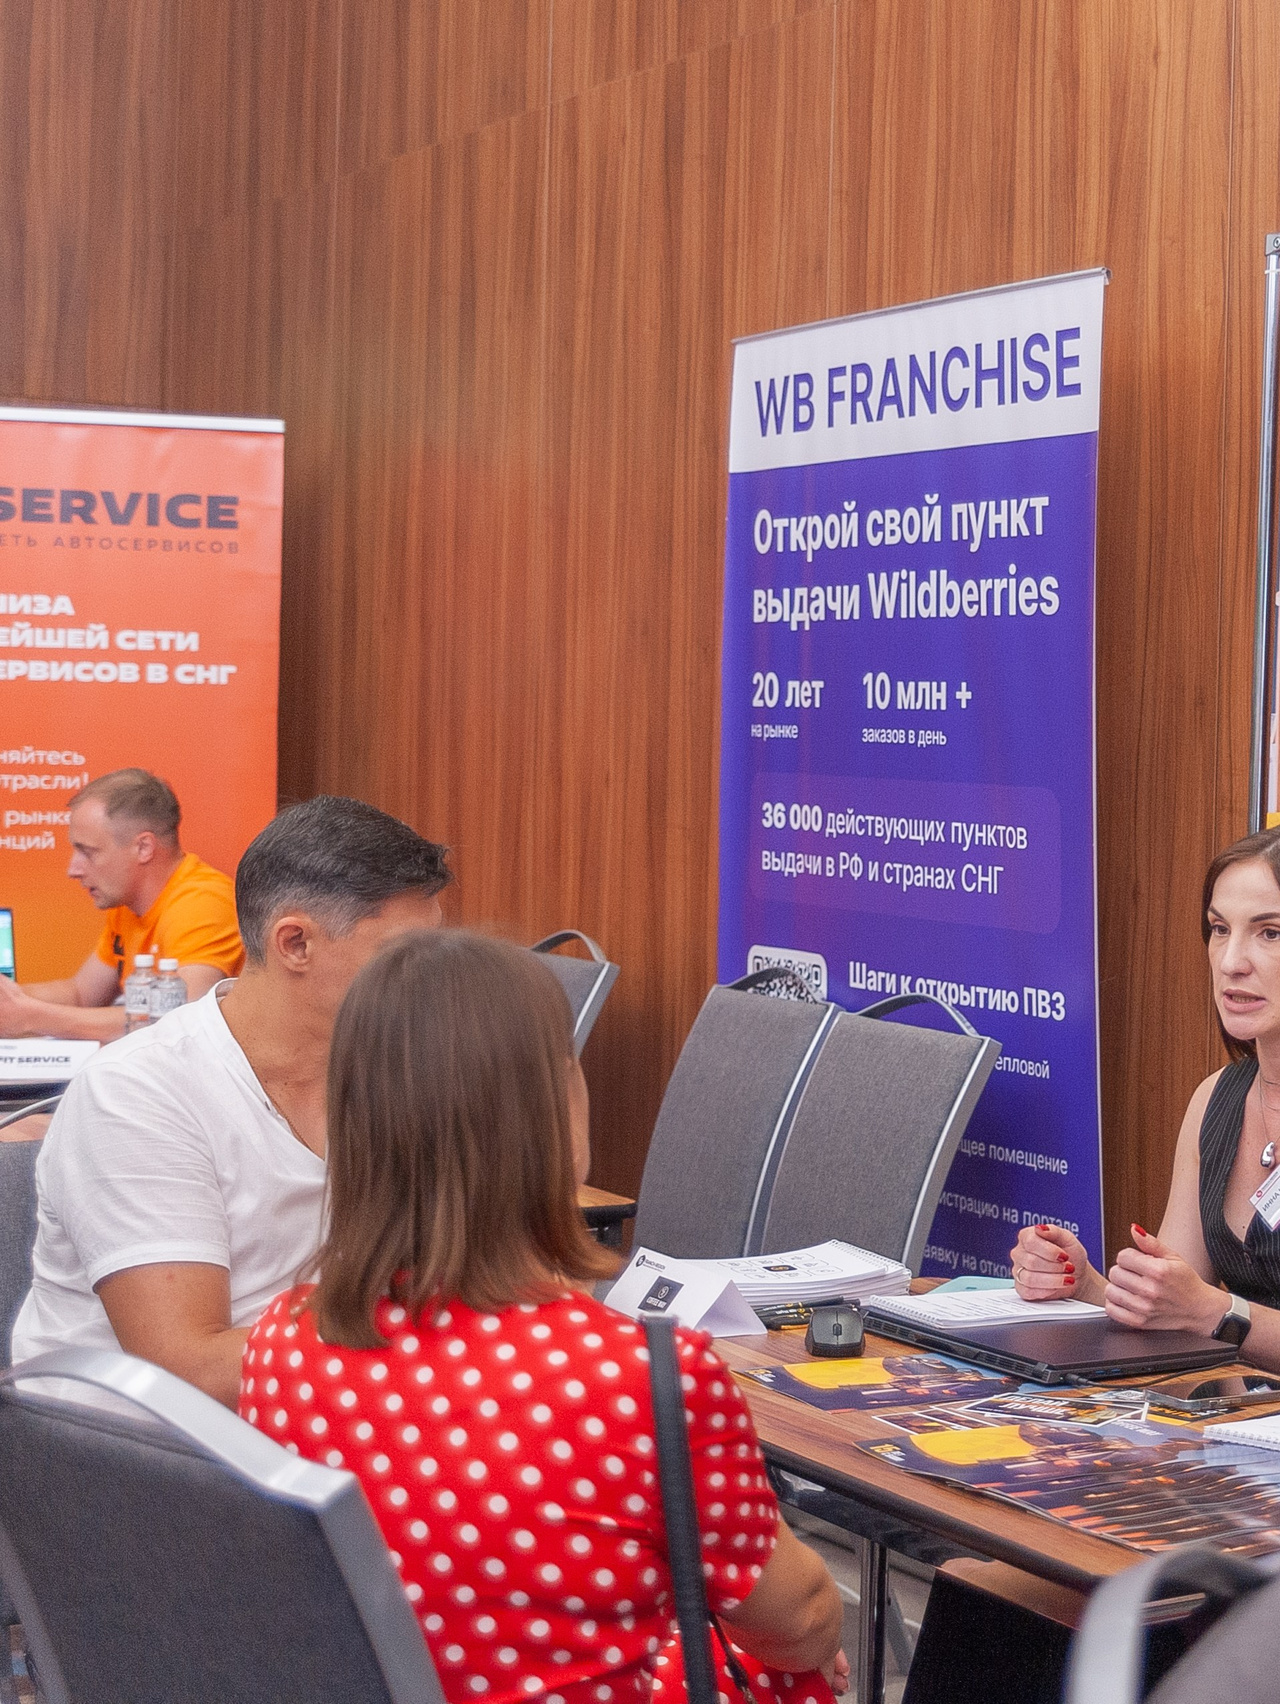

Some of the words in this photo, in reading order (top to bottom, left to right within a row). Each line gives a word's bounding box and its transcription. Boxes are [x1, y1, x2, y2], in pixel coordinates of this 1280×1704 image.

[754, 372, 815, 438] WB
[827, 326, 1082, 429] FRANCHISE
[753, 502, 859, 562] Открой
[866, 493, 942, 546] свой
[950, 496, 1049, 553] пункт
[54, 536, 240, 554] АВТОСЕРВИСОВ
[752, 583, 860, 631] выдачи
[868, 564, 1060, 620] Wildberries
[116, 629, 200, 652] СЕТИ
[146, 663, 169, 684] В
[174, 664, 238, 686] СНГ
[752, 671, 780, 708] 20
[784, 679, 825, 708] лет
[862, 672, 891, 710] 10
[896, 680, 948, 711] млн
[751, 723, 762, 738] на
[763, 723, 798, 741] рынке
[862, 726, 906, 744] заказов
[908, 729, 916, 745] в
[917, 730, 947, 748] день
[762, 802, 786, 829] 36
[789, 804, 823, 832] 000
[825, 808, 946, 846] действующих
[951, 821, 1028, 852] пунктов
[762, 850, 822, 878] выдачи
[825, 857, 835, 878] в
[839, 852, 864, 881] РФ
[868, 860, 879, 882] и
[882, 862, 956, 892] странах
[961, 864, 1004, 894] СНГ
[849, 962, 897, 995] Шаги
[915, 978, 1020, 1014] открытию
[1023, 986, 1066, 1022] ПВЗ
[988, 1144, 1068, 1176] помещение
[1002, 1206, 1018, 1224] на
[1262, 1191, 1280, 1212] ИННА
[962, 1254, 977, 1272] на
